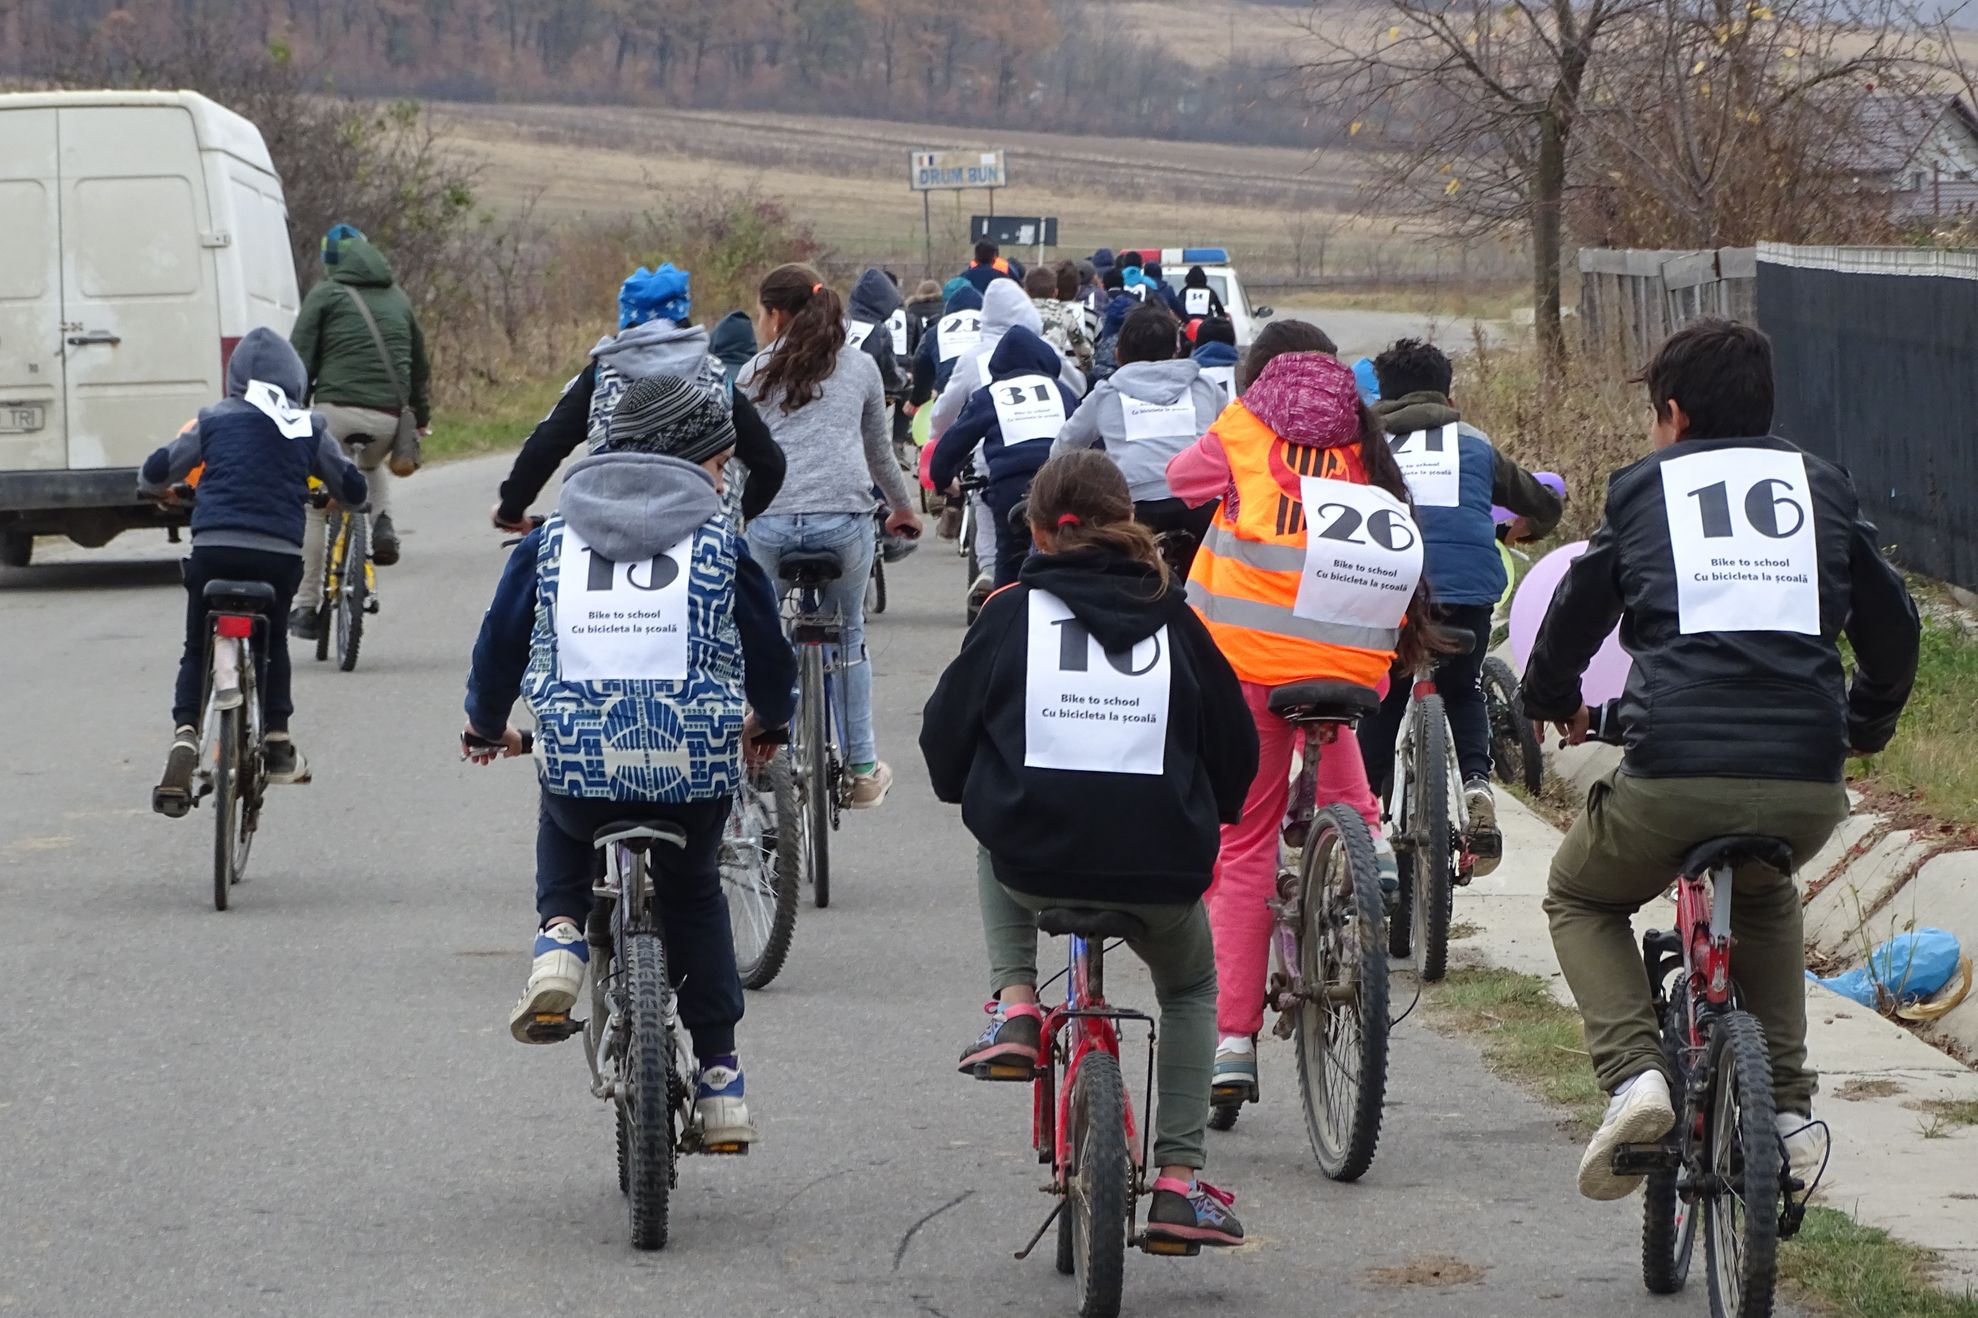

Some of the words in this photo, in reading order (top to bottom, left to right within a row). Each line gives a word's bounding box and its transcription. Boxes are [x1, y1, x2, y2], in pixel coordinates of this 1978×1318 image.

[919, 168, 963, 184] DRUM
[968, 167, 998, 183] BUN
[943, 318, 982, 334] 23
[1000, 384, 1051, 405] 31
[1687, 478, 1804, 539] 16
[1318, 502, 1415, 552] 26
[1333, 559, 1353, 570] Bike
[1356, 564, 1365, 572] to
[1368, 566, 1397, 577] school
[1711, 558, 1735, 567] Bike
[1739, 559, 1750, 567] to
[1754, 558, 1790, 567] school
[1316, 570, 1328, 578] Cu
[1330, 571, 1367, 586] bicicleta
[1370, 579, 1378, 587] la
[1694, 573, 1709, 581] Cu
[1712, 572, 1758, 581] bicicleta
[1761, 572, 1772, 581] la
[588, 610, 610, 619] Bike
[614, 611, 624, 619] to
[627, 609, 661, 619] school
[571, 625, 585, 634] Cu
[587, 624, 630, 634] bicicleta
[633, 624, 642, 633] la
[1061, 694, 1085, 703] Bike
[1088, 696, 1100, 704] to
[1103, 696, 1140, 707] school
[1042, 708, 1056, 718] Cu
[1059, 708, 1106, 720] bicicleta
[1109, 711, 1119, 721] la
